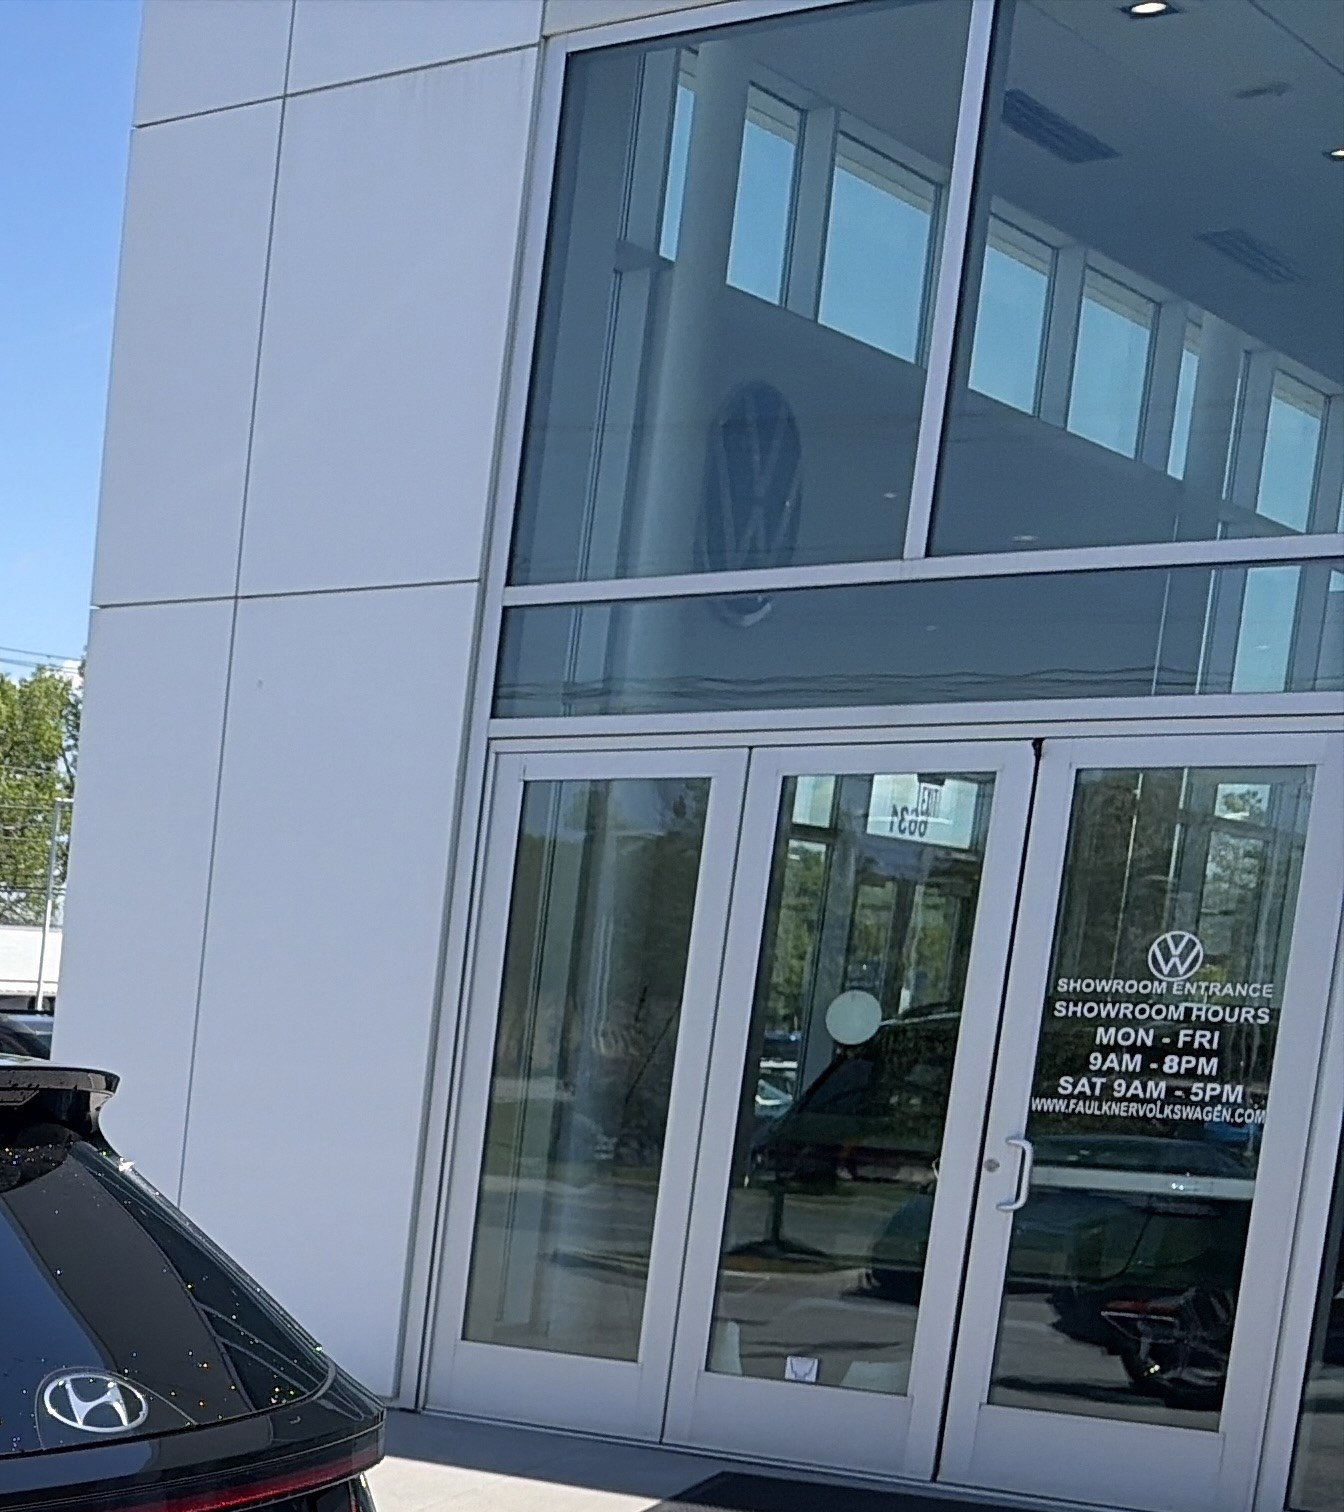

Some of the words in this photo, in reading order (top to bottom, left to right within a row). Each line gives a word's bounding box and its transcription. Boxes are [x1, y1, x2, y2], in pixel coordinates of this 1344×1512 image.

[1148, 931, 1203, 981] VW
[1057, 978, 1166, 995] SHOWROOM
[1173, 982, 1273, 998] ENTRANCE
[1053, 1001, 1185, 1021] SHOWROOM
[1191, 1005, 1270, 1024] HOURS
[1095, 1027, 1154, 1047] MON
[1177, 1031, 1219, 1050] FRI
[1089, 1053, 1141, 1072] 9AM
[1162, 1055, 1218, 1076] 8PM
[1057, 1076, 1106, 1095] SAT
[1113, 1079, 1166, 1099] 9AM
[1190, 1083, 1243, 1103] 5PM
[1031, 1096, 1267, 1124] WWW.FAULKNERVOLKSWAGEN.COM
